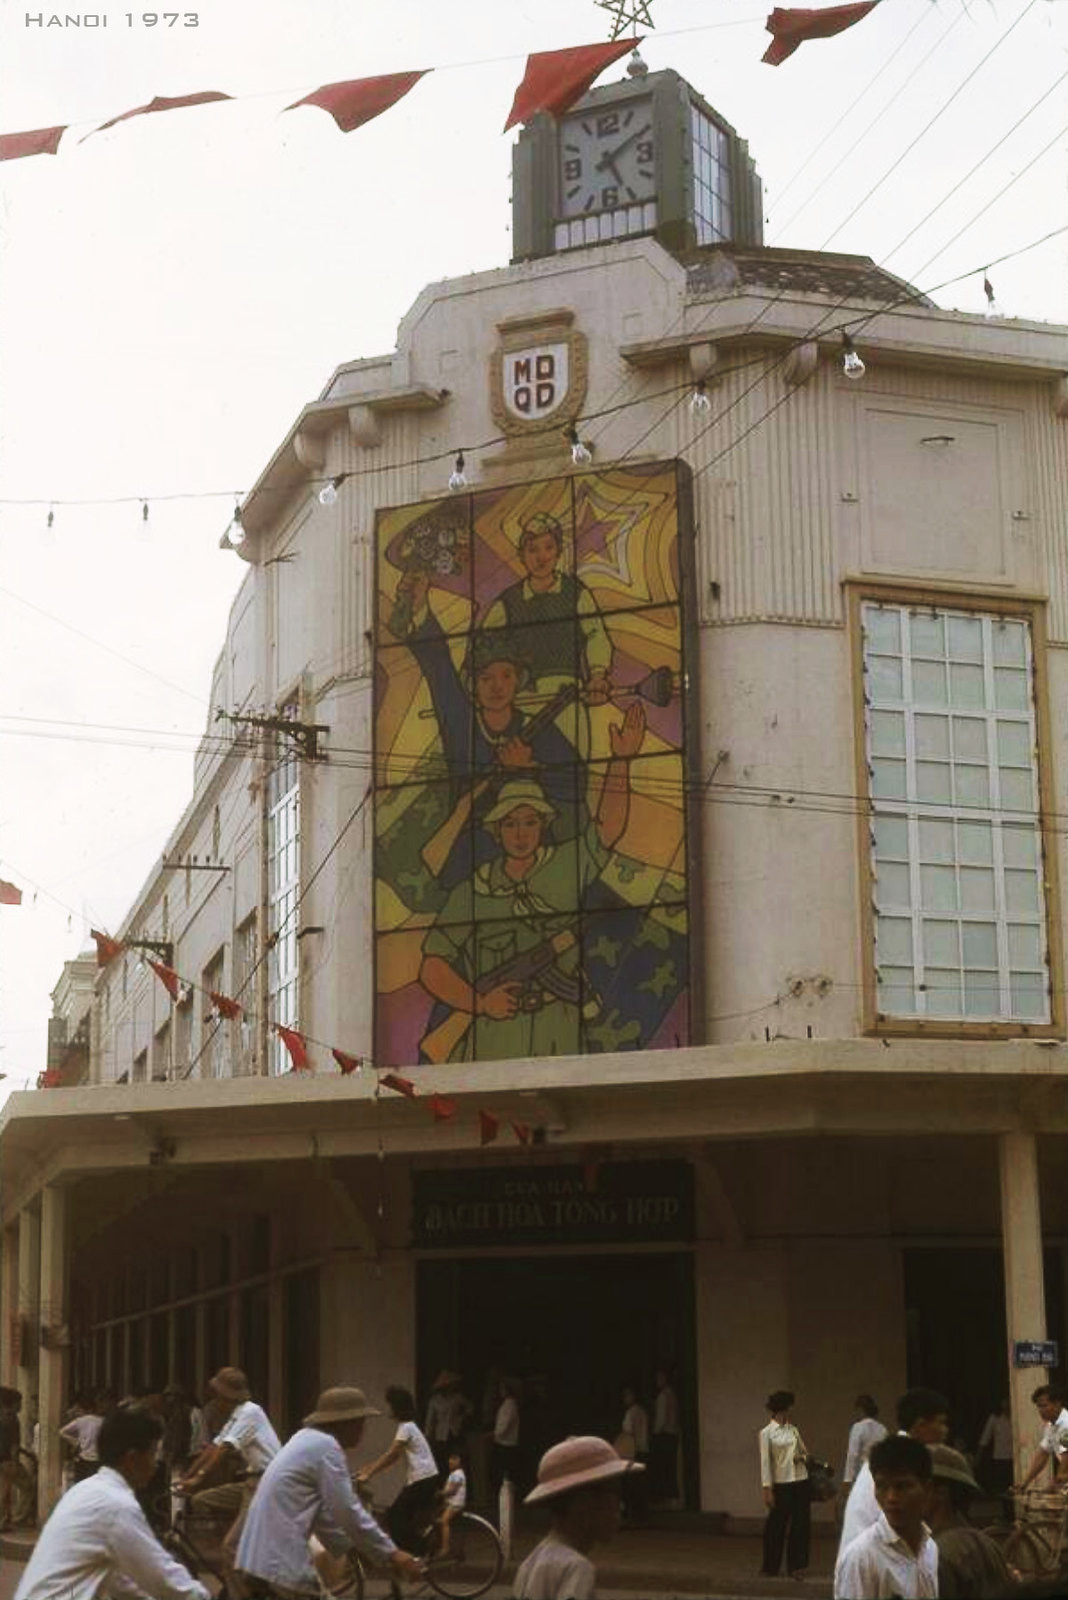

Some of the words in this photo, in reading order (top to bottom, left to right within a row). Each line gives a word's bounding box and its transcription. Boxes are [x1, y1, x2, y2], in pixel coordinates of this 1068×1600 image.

[597, 113, 620, 139] 12
[636, 141, 654, 164] 3
[564, 158, 582, 181] 9
[602, 186, 619, 208] 6
